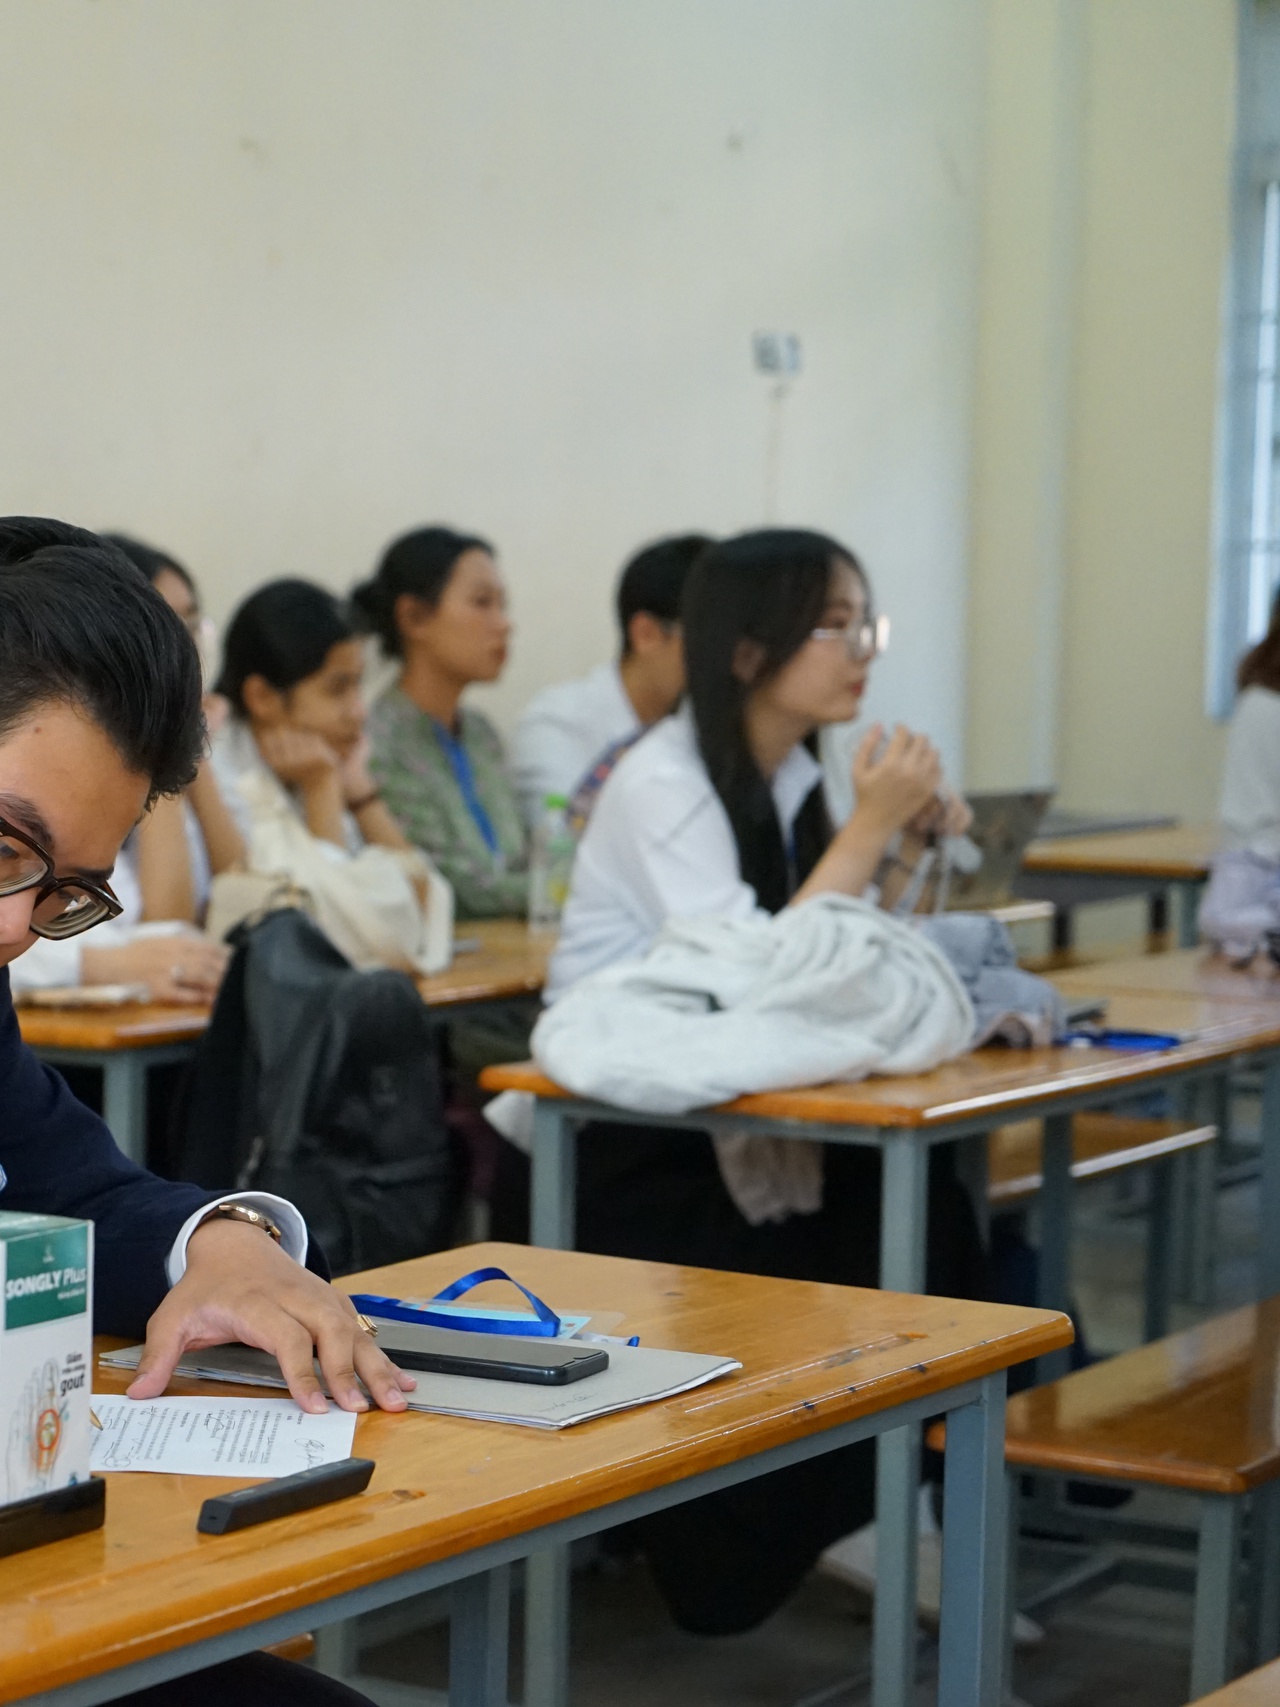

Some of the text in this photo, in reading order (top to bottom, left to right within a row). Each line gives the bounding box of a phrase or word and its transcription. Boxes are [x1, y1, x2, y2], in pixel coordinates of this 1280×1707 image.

[5, 1271, 64, 1299] SONGLY
[63, 1267, 87, 1285] Plus
[60, 1373, 85, 1397] gout
